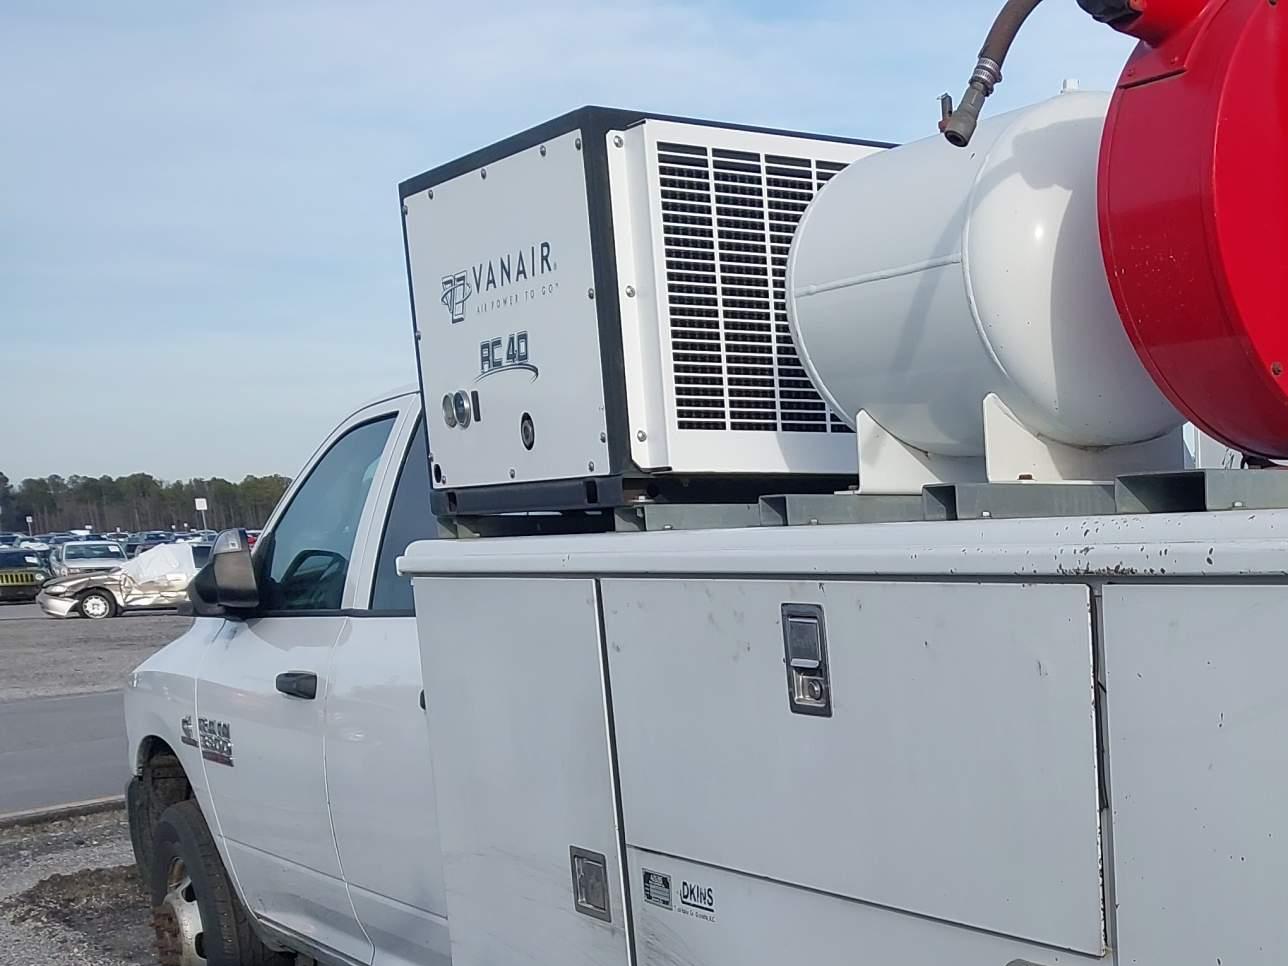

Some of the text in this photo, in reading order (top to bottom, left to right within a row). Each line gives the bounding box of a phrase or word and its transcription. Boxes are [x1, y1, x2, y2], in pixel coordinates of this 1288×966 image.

[472, 241, 552, 294] VANAIR
[525, 289, 535, 303] TO
[506, 330, 529, 363] 40
